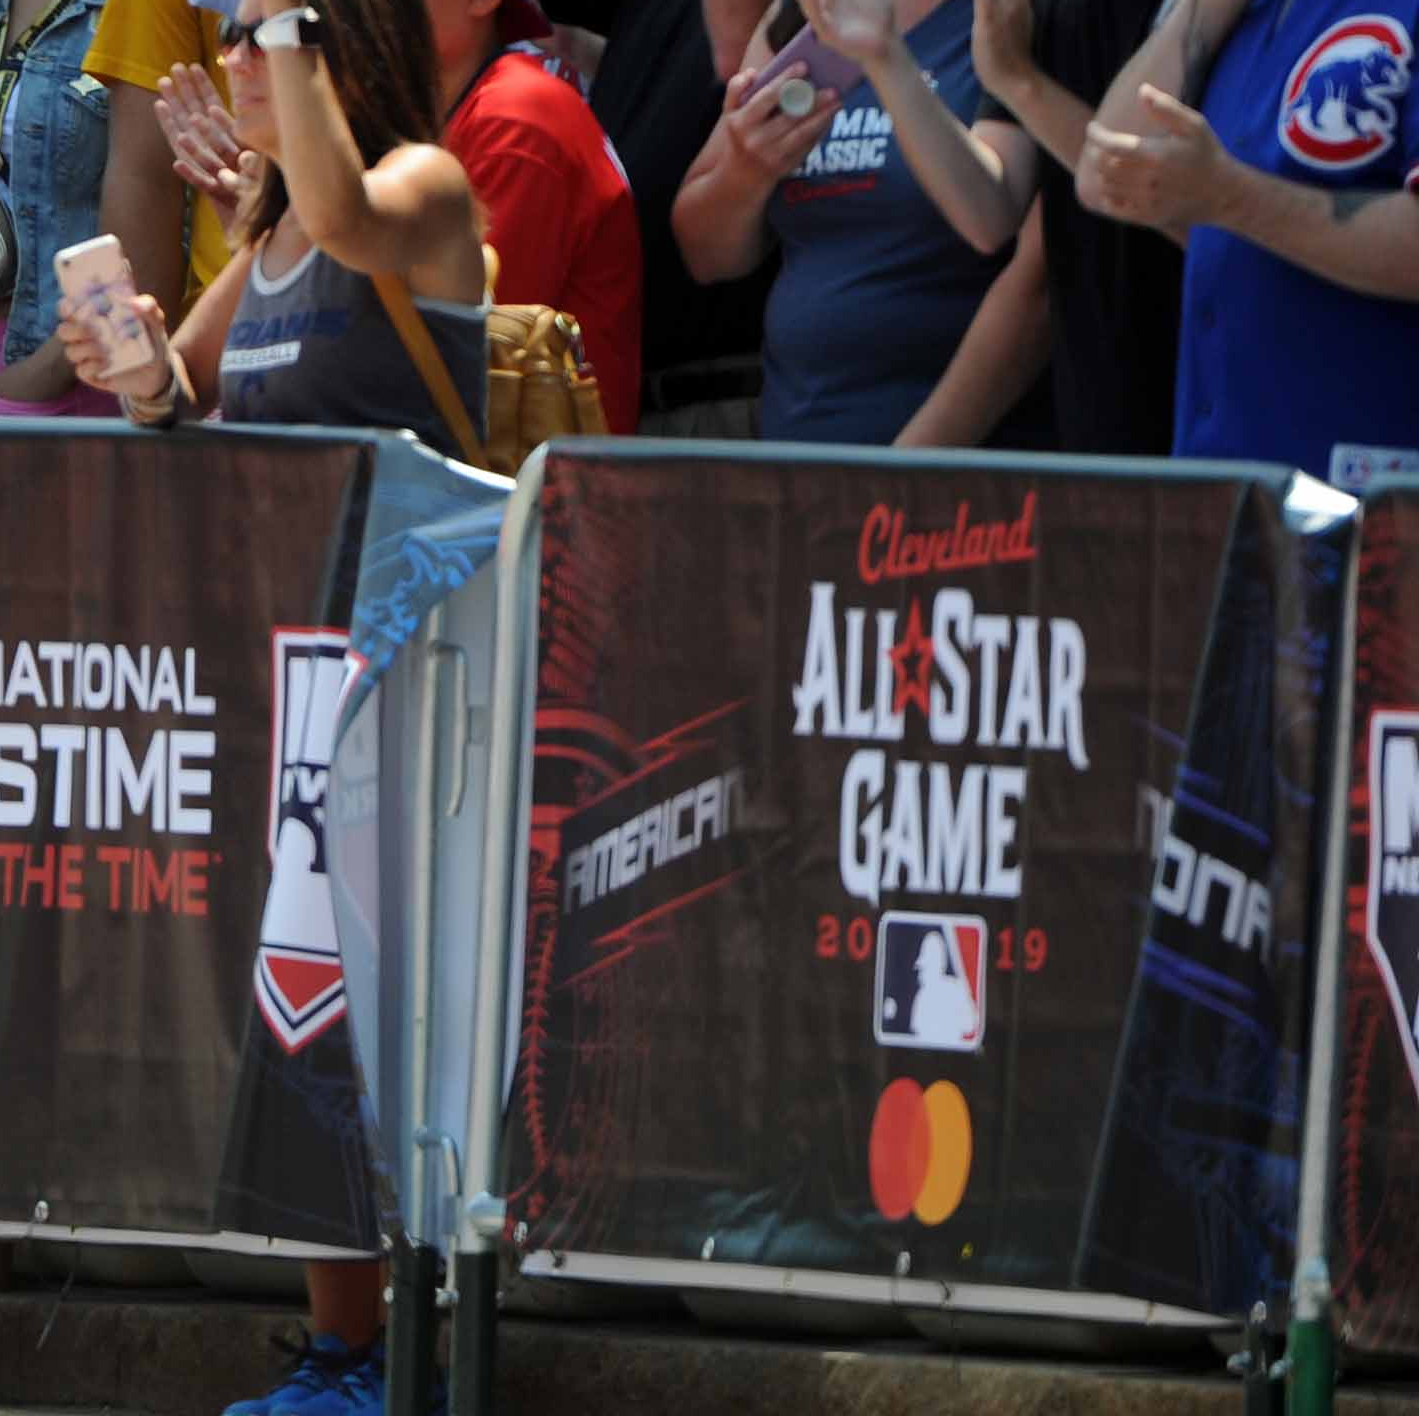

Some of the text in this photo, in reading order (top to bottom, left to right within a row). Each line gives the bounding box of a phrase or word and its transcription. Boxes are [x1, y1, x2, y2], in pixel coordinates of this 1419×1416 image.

[857, 492, 1037, 585] Cleveland
[792, 581, 1090, 771] ALL STAR
[838, 749, 1029, 905] GAME
[99, 846, 209, 917] TIME
[815, 915, 1049, 973] 20 19
